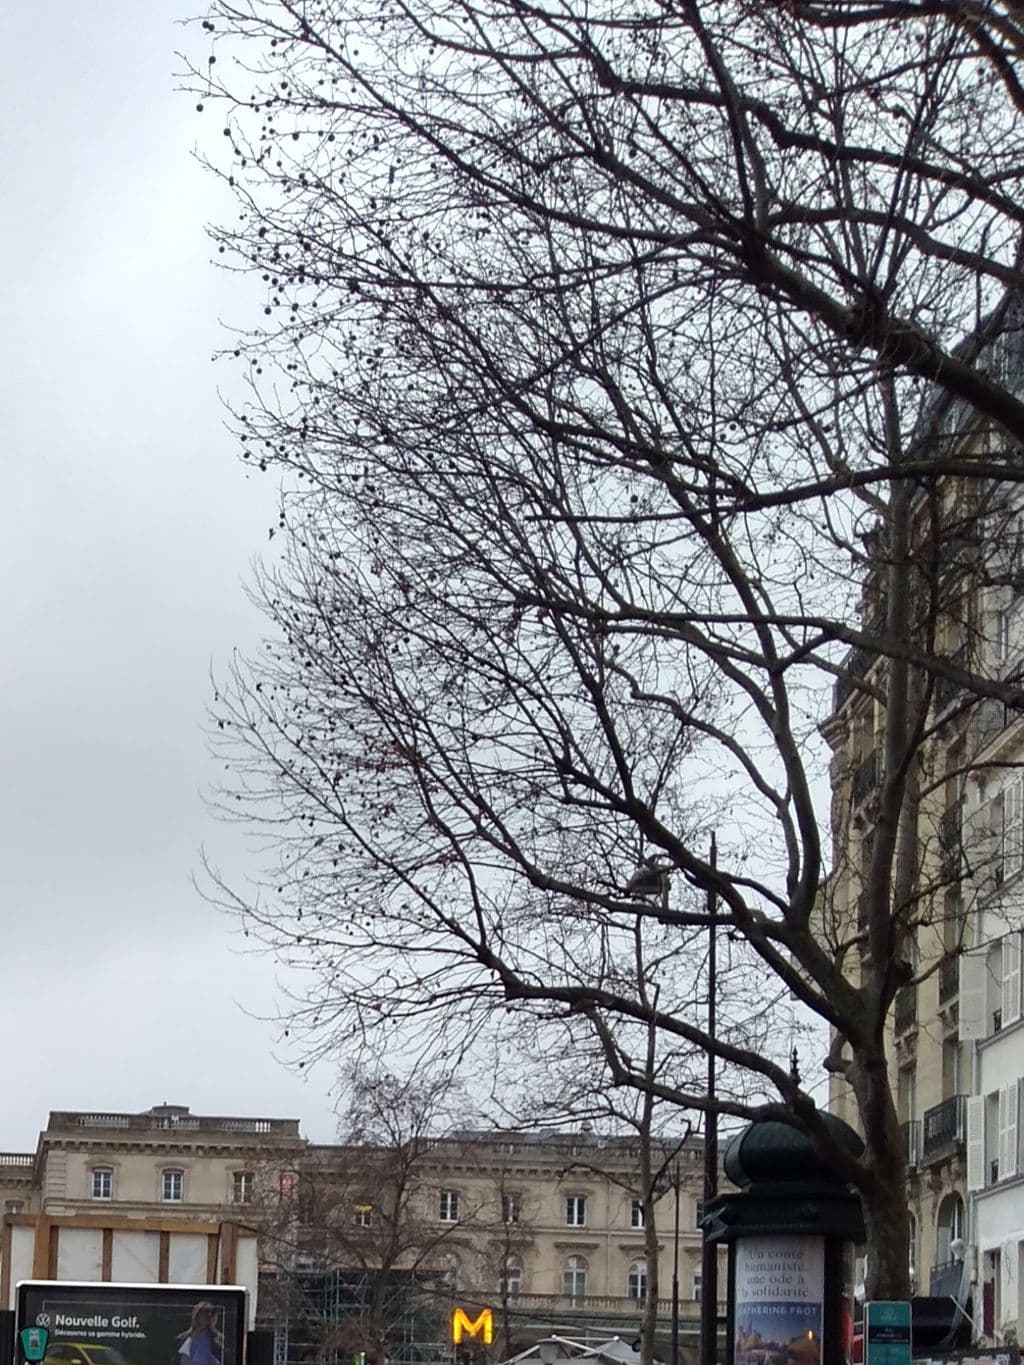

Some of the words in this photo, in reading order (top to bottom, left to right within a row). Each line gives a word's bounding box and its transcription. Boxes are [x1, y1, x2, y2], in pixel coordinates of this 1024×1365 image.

[55, 1314, 109, 1327] Nouvelle
[111, 1315, 140, 1329] Golf.
[452, 1308, 494, 1345] M
